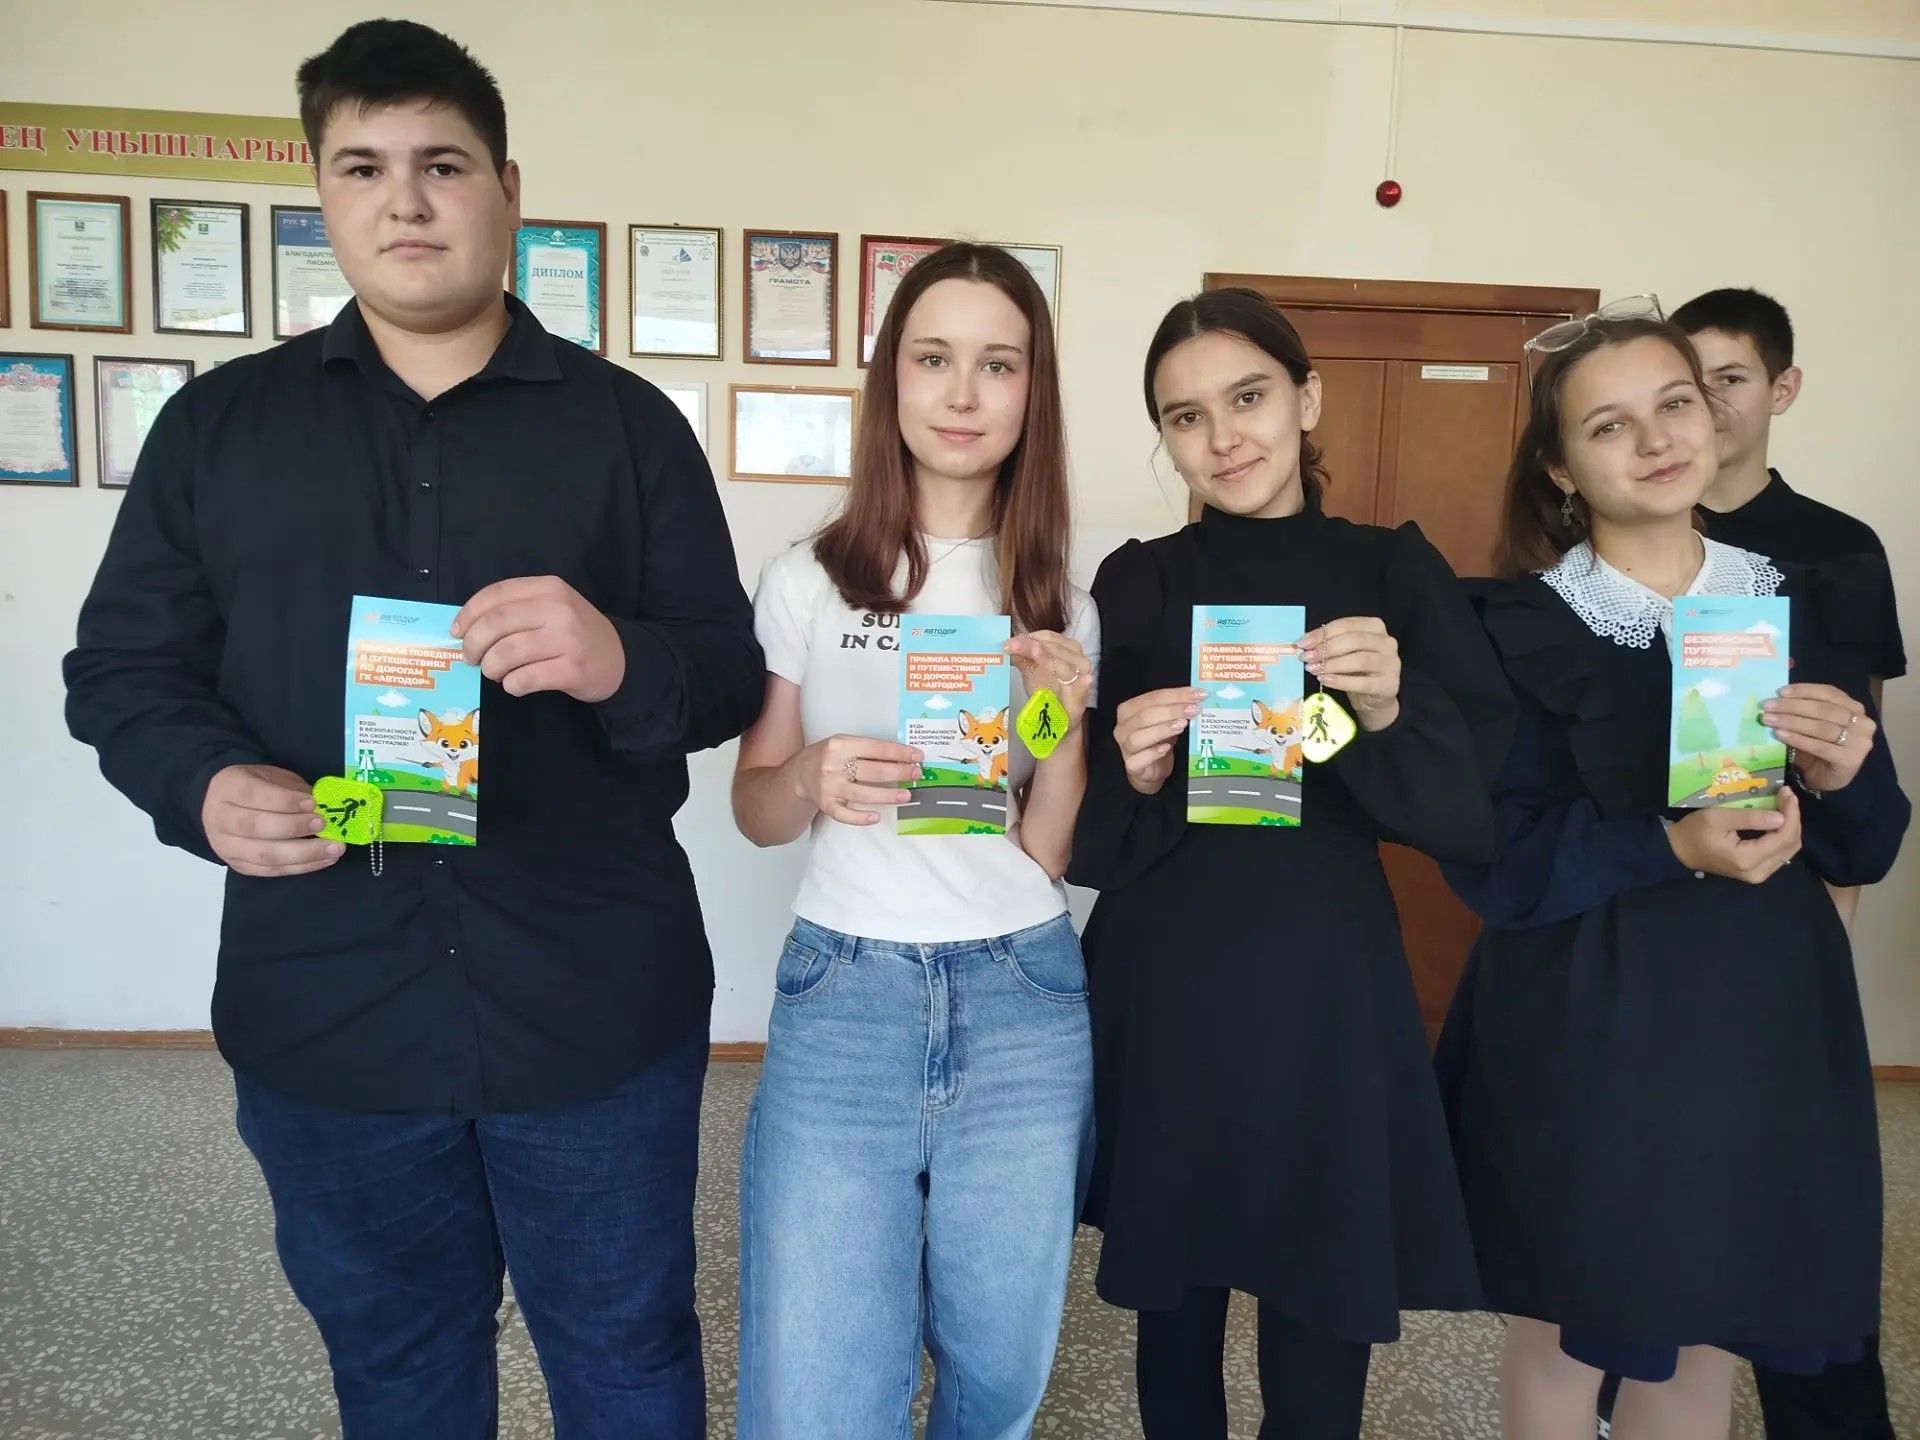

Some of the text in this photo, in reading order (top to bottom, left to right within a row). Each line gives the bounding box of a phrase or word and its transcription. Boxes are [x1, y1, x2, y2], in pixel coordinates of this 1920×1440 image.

[531, 267, 584, 279] ДИПЛОМ
[768, 277, 811, 285] ГРАМОТА
[839, 633, 869, 649] IN
[369, 655, 446, 668] ПУТЕШЕСТВИЯХ
[951, 656, 1001, 665] ПОВЕДЕНИЯ
[360, 663, 423, 675] ПО ДОРОГАМ
[1216, 663, 1257, 671] ДОРОГАМ
[359, 673, 431, 685] ГК «АВТОДОР»
[924, 673, 963, 681] ДОРОГАМ
[1213, 672, 1263, 680] «АВТОДОР»
[922, 682, 969, 690] «АВТОДОР»
